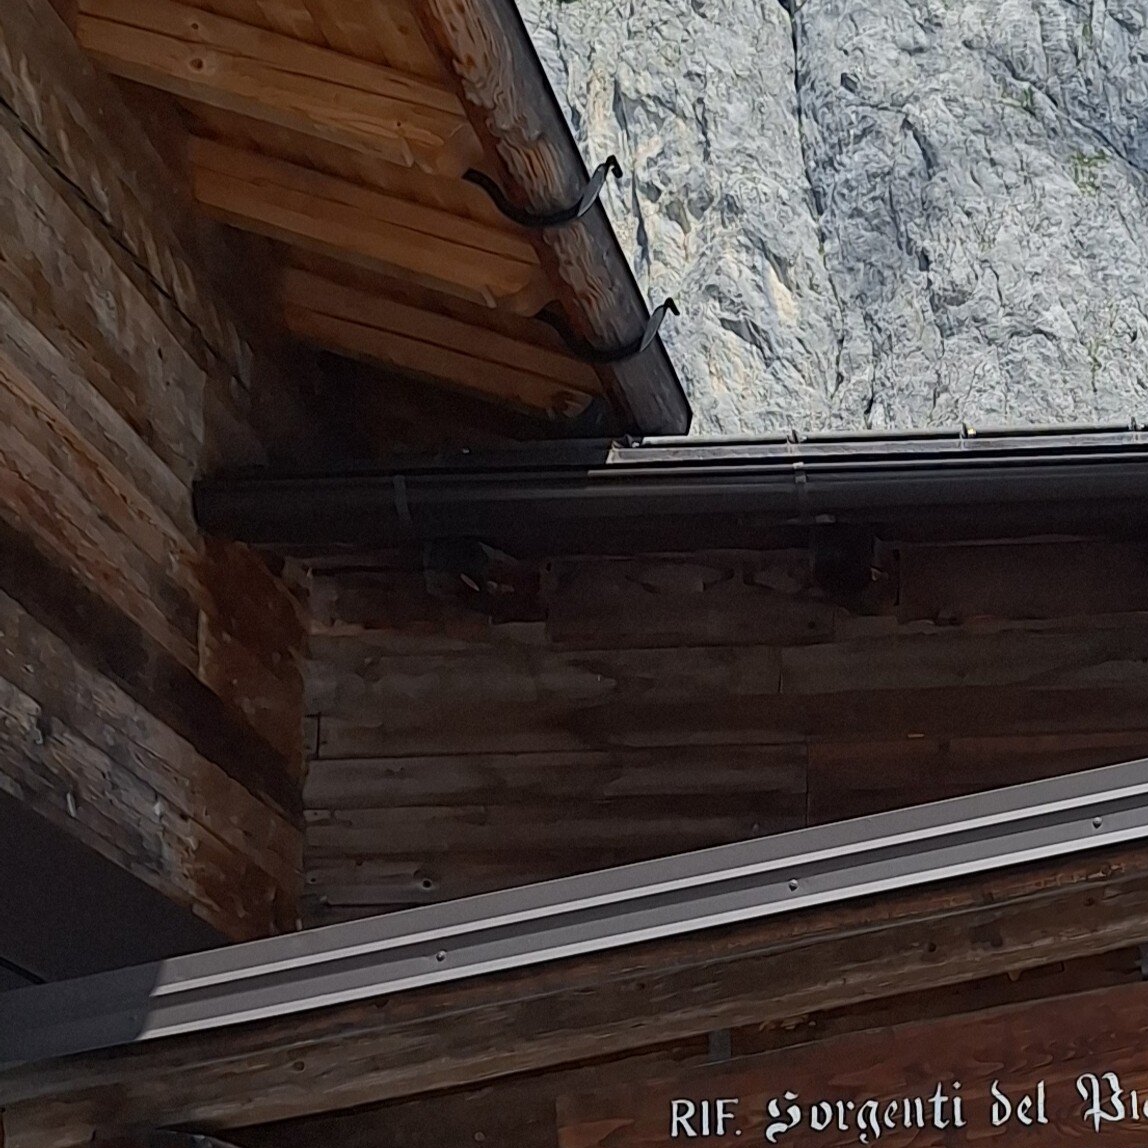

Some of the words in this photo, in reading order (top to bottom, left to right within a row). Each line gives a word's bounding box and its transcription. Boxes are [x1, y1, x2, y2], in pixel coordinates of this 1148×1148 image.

[671, 1098, 742, 1137] RIF.
[765, 1081, 967, 1144] Sorgenti
[991, 1079, 1049, 1127] del
